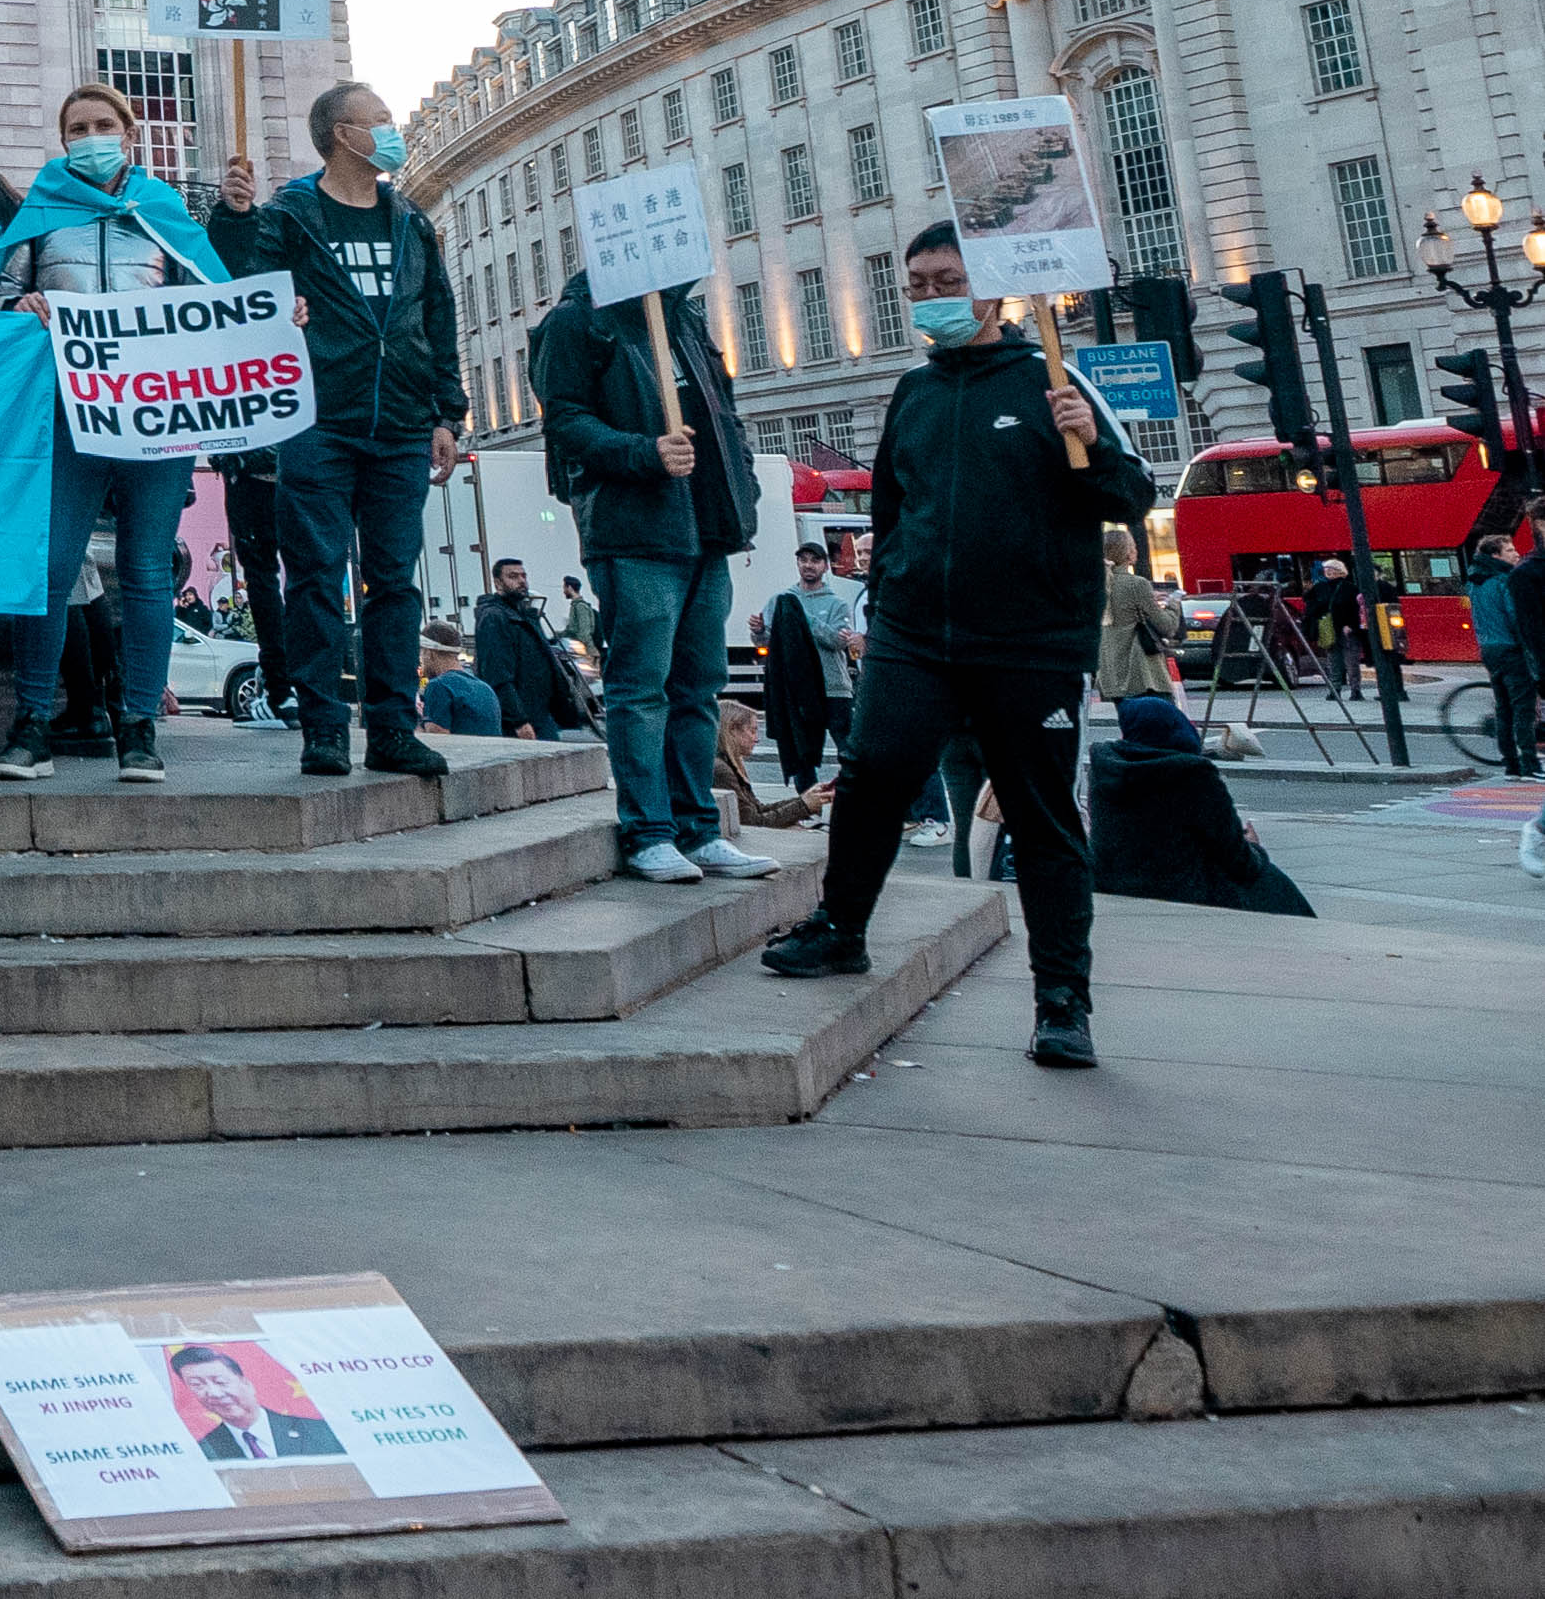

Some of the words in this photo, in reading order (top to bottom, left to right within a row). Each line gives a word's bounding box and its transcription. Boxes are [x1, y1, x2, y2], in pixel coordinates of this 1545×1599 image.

[598, 228, 689, 268] 時代革命
[1011, 238, 1054, 255] 天安門
[57, 289, 278, 339] MILLIONS
[63, 339, 120, 371] OF
[1087, 350, 1117, 363] BUS
[1121, 347, 1159, 361] LANE
[67, 352, 304, 404] UYGHURS
[1131, 388, 1171, 402] BOTH
[75, 403, 122, 436] IN
[132, 387, 300, 438] CAMPS
[299, 1360, 336, 1376] SAY
[338, 1358, 369, 1373] NO
[370, 1356, 399, 1371] TO
[401, 1354, 435, 1368] CCP
[5, 1376, 71, 1394] SHAME
[73, 1372, 140, 1389] SHAME
[39, 1400, 59, 1416] XI
[61, 1396, 133, 1414] JINPING
[350, 1407, 387, 1423] SAY
[390, 1405, 427, 1420] YES
[427, 1403, 456, 1417] TO
[373, 1426, 469, 1446] FREEDOM
[45, 1447, 114, 1465] SHAME
[116, 1441, 185, 1460] SHAME
[98, 1466, 160, 1485] CHINA
